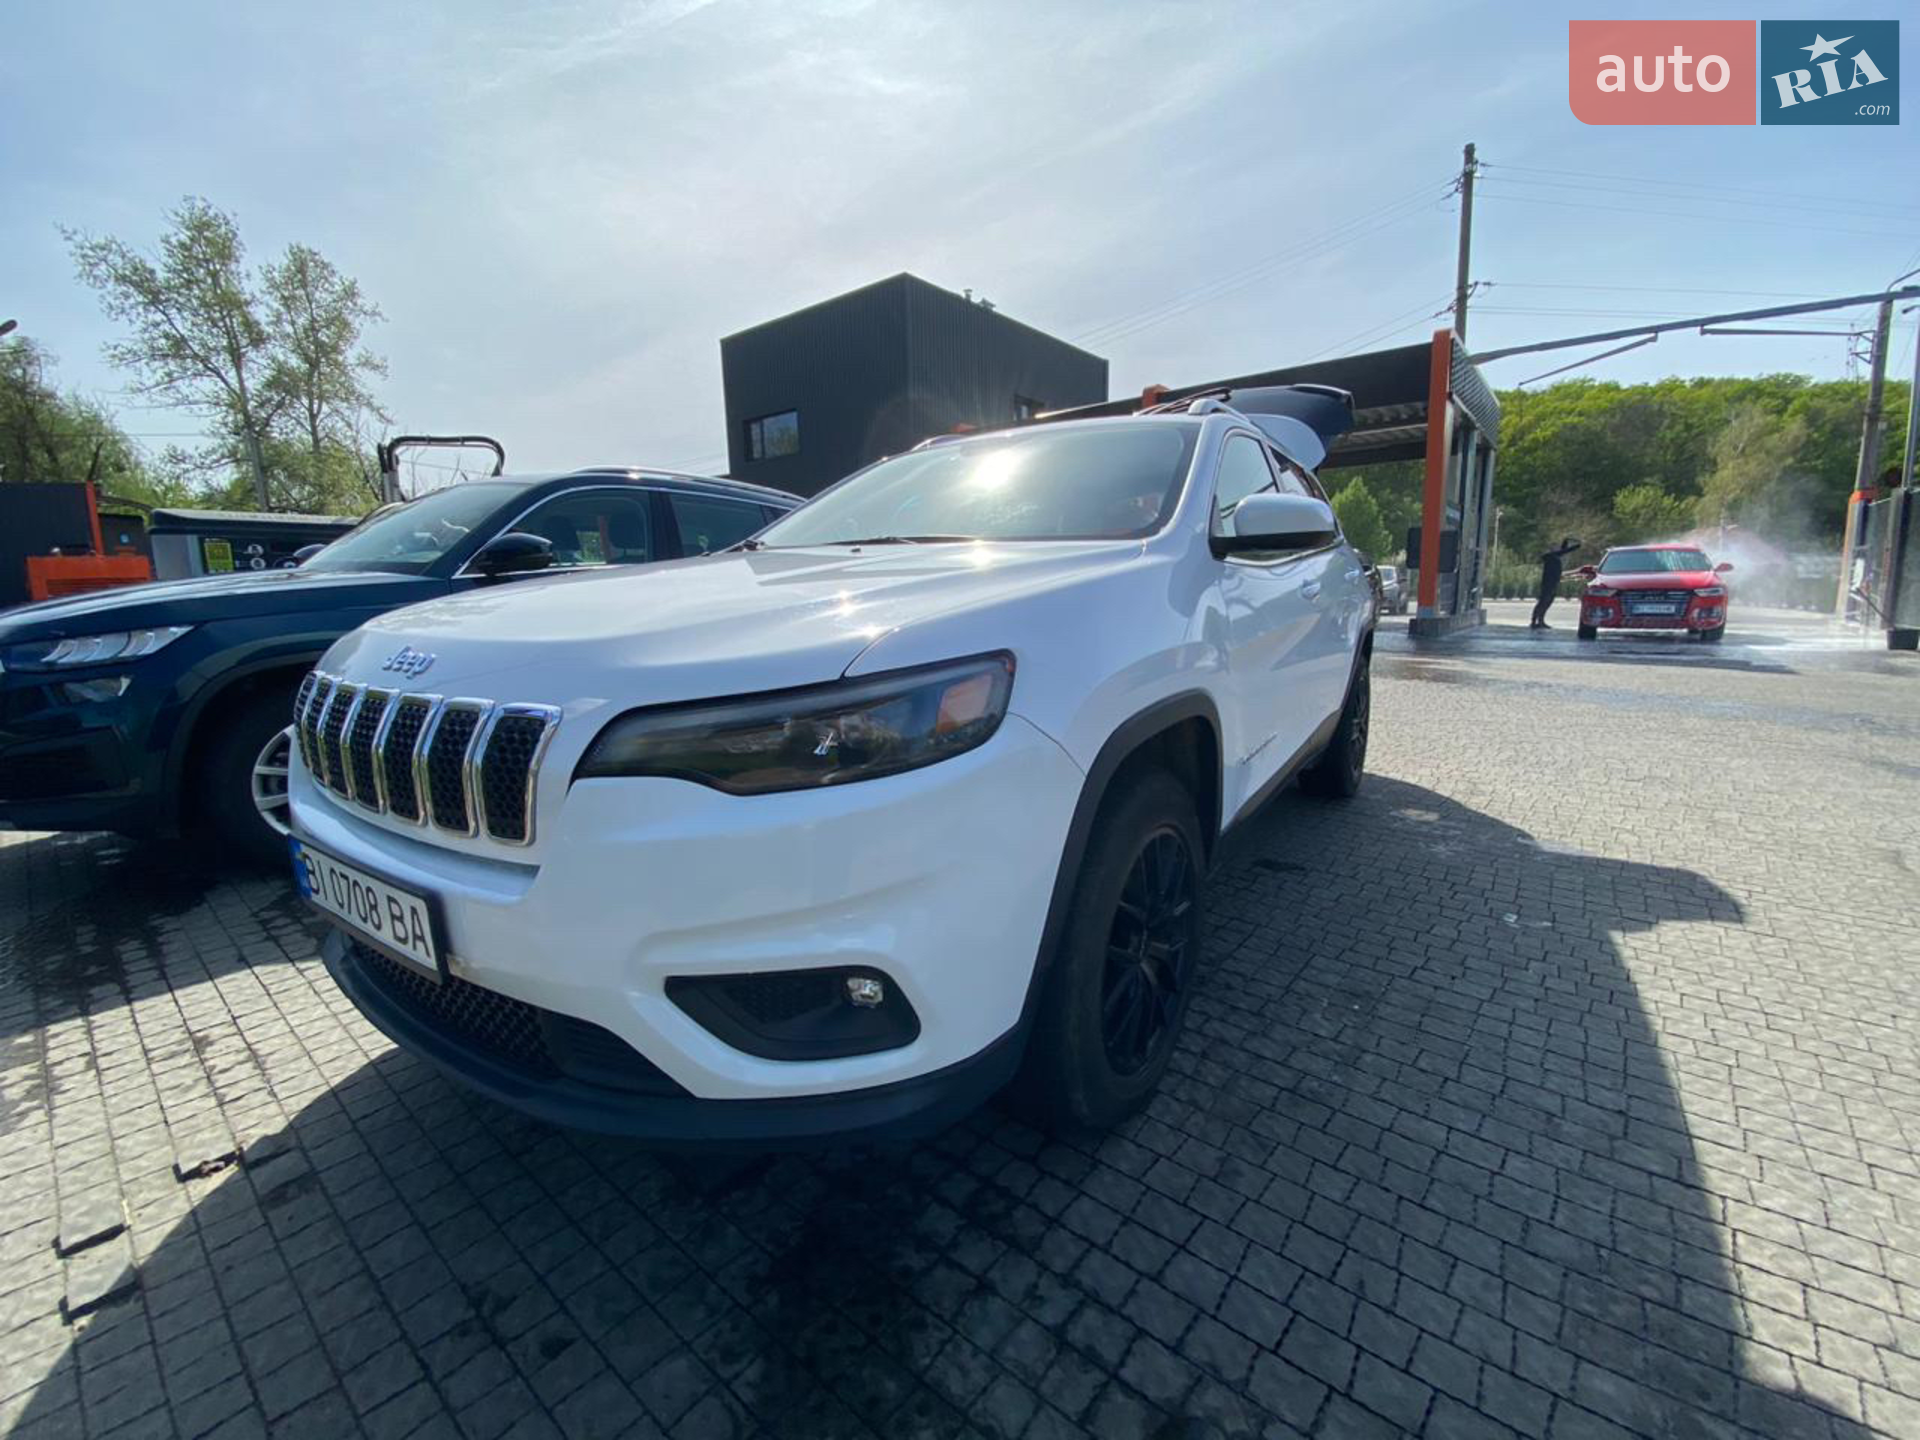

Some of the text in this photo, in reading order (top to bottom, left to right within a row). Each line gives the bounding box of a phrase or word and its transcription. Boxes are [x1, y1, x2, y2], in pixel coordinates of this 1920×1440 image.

[381, 645, 436, 680] Jeep
[303, 851, 432, 958] BI 0708 BA
